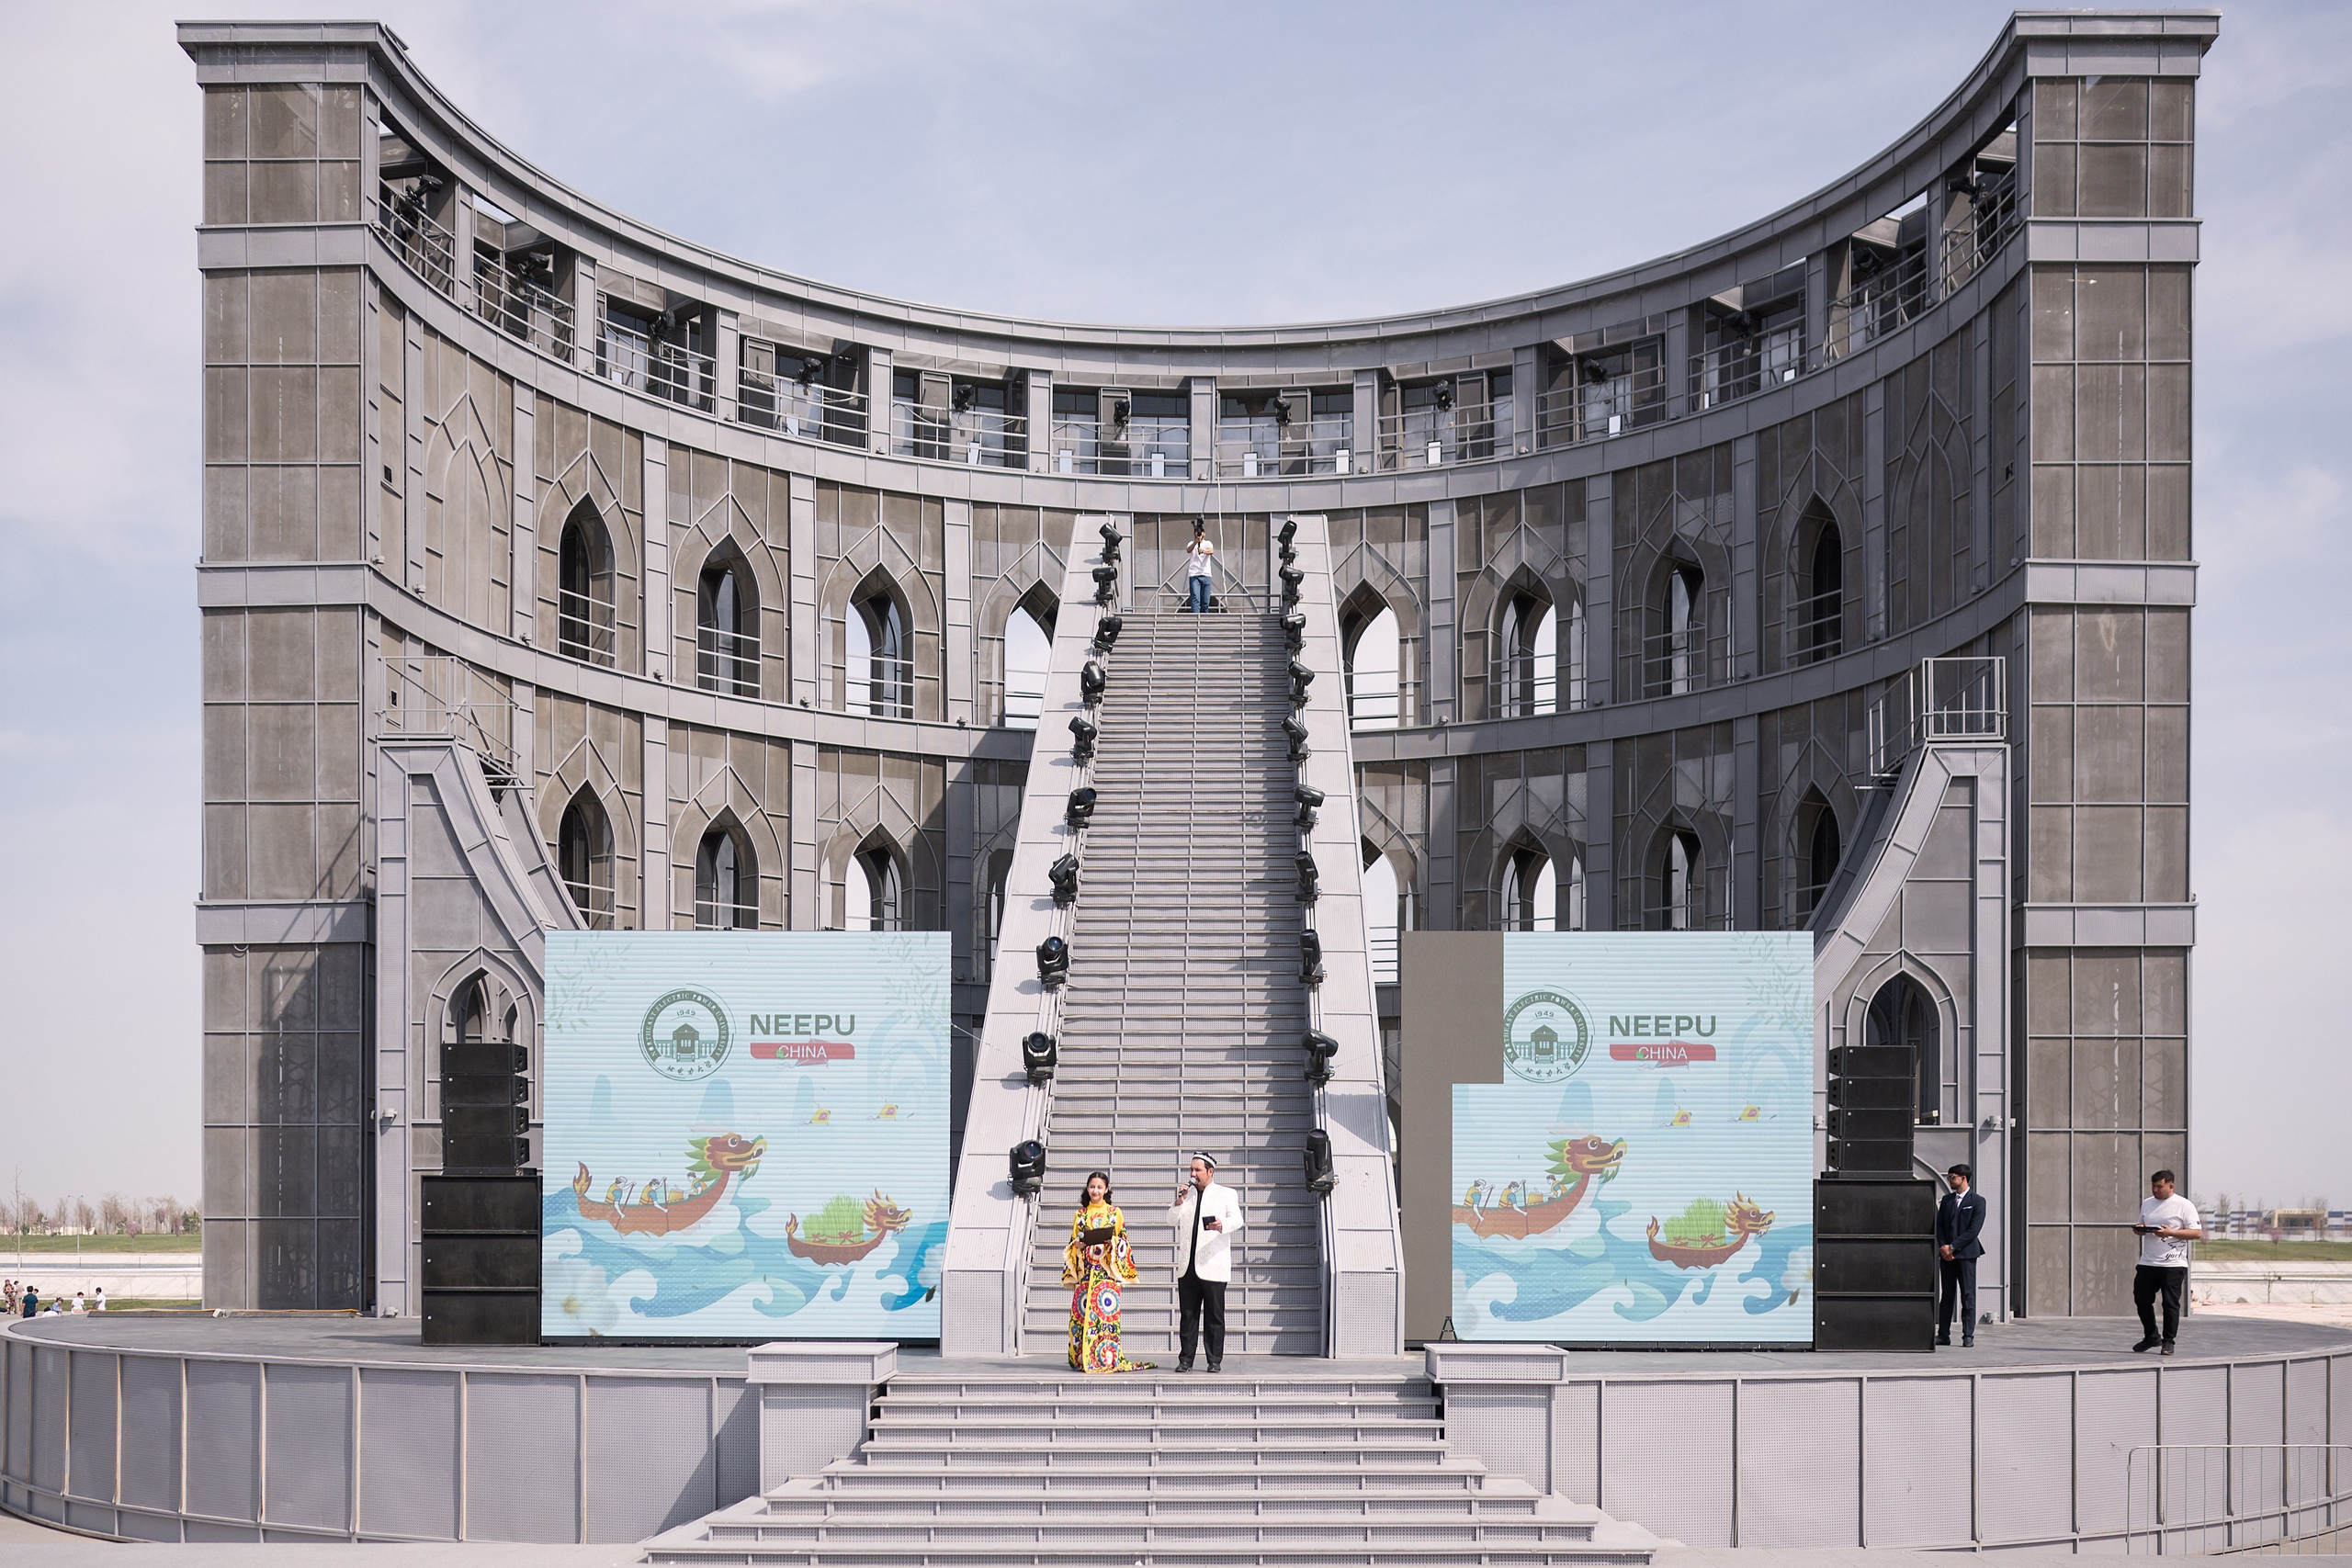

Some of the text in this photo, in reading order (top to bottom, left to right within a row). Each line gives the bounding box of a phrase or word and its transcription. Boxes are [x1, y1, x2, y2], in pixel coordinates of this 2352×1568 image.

[676, 1009, 696, 1017] 1949
[645, 993, 727, 1057] NORTHEAST ELECTRIC POWER UNIVERSITY
[750, 1014, 855, 1037] NEEPU
[1512, 995, 1548, 1013] ELECTRIC
[1550, 995, 1576, 1012] POWER
[1574, 1012, 1586, 1059] UNIVERSITY
[1610, 1015, 1716, 1037] NEEPU
[778, 1045, 828, 1058] CHINA
[1638, 1046, 1689, 1060] CHINA
